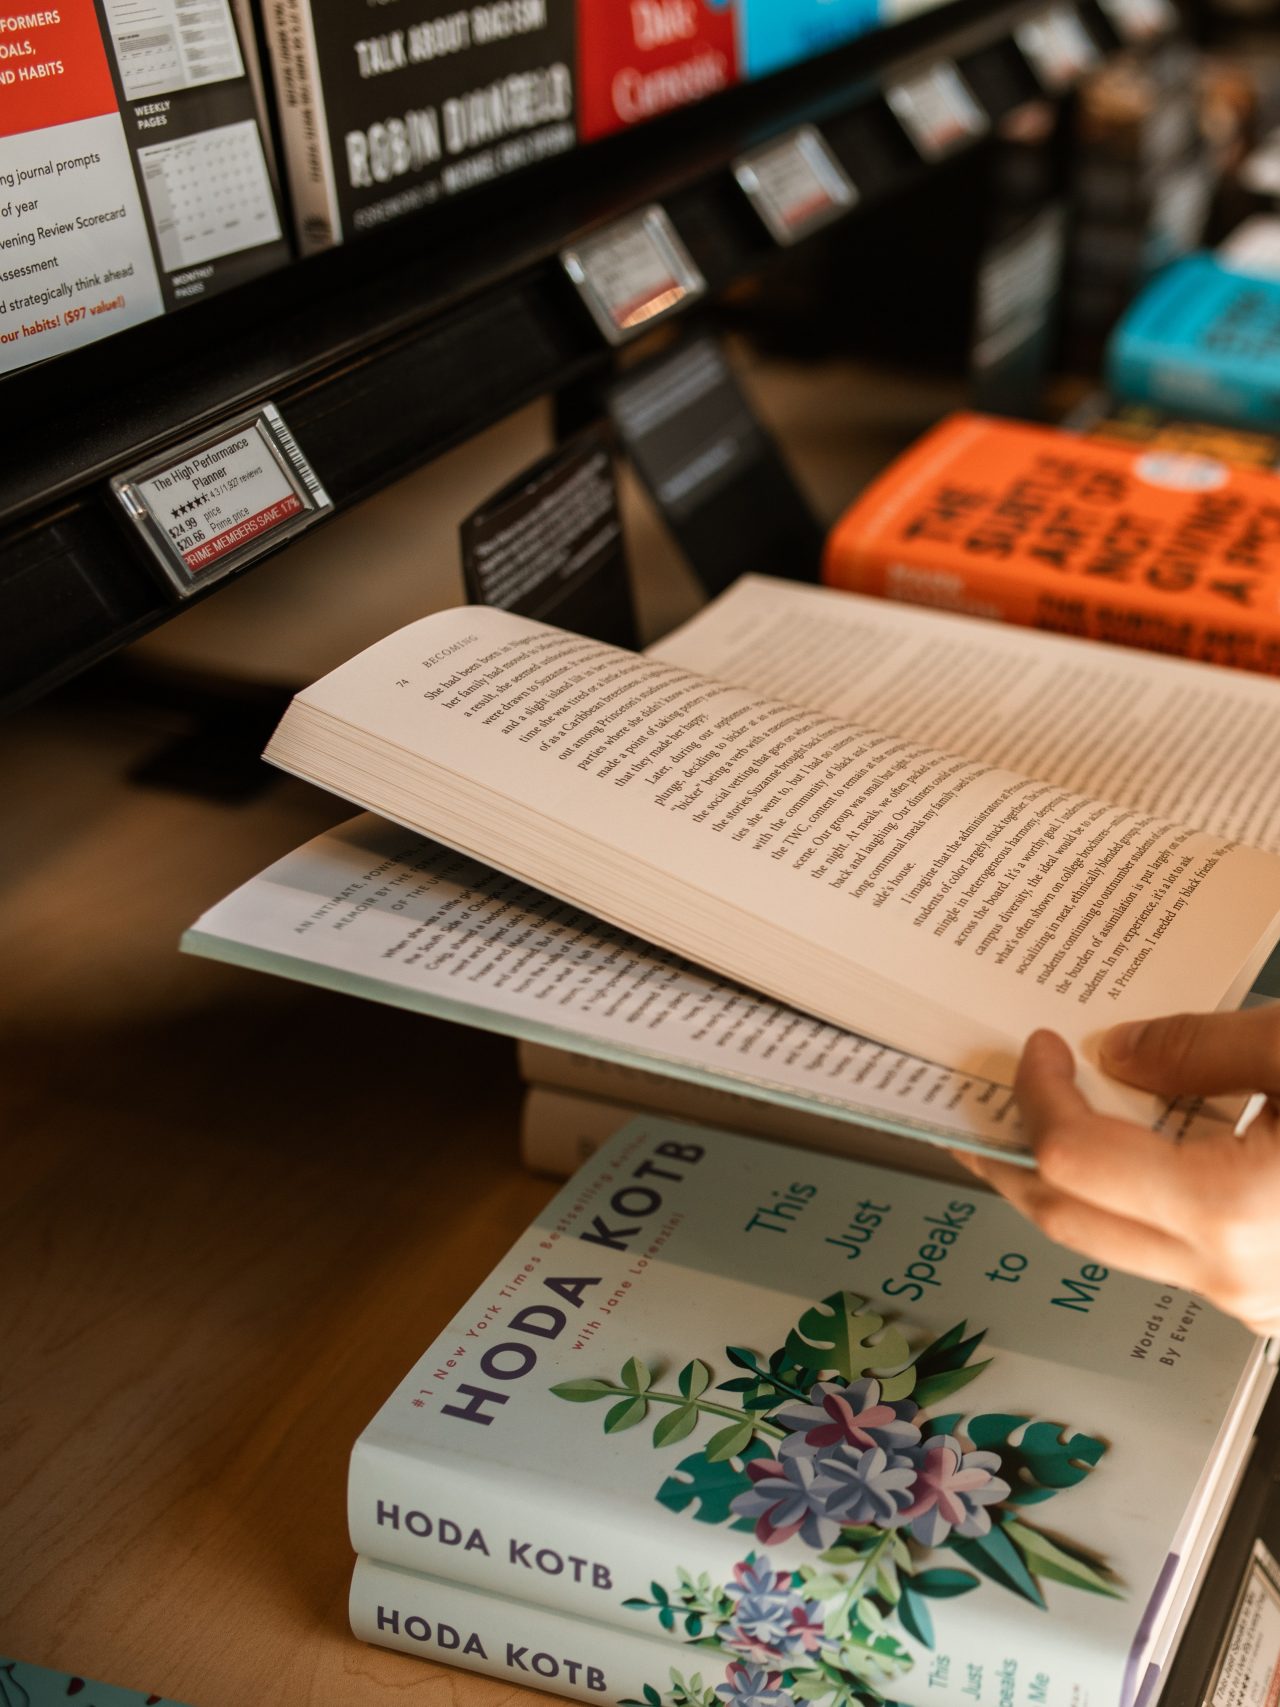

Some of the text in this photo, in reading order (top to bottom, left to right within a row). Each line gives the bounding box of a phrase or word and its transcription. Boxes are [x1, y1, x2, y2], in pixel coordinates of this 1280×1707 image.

[0, 10, 61, 33] FORMERS
[354, 29, 408, 78] TALK
[408, 10, 471, 64] ABOUT
[18, 60, 65, 81] HABITS
[134, 100, 171, 117] WEEKLY
[137, 115, 168, 130] PAGES
[16, 165, 54, 186] journal
[56, 154, 101, 176] prompts
[345, 104, 442, 188] ROBIN
[1, 199, 39, 218] of year
[36, 219, 75, 240] Review
[75, 205, 127, 230] Scorecard
[9, 282, 74, 312] strategically
[75, 273, 102, 292] think
[104, 263, 134, 284] ahead
[1, 330, 20, 344] our
[22, 315, 61, 338] habits!
[63, 306, 87, 327] ($97
[152, 438, 249, 492] The High Performance
[192, 467, 227, 491] Planner
[223, 477, 239, 492] 1,927
[239, 466, 263, 483] reviews
[169, 505, 222, 539] $24.99 price
[177, 506, 250, 552] $20.66 Prime price
[212, 520, 259, 552] MEMBERS
[256, 509, 282, 527] SAVE
[421, 634, 478, 668] BECOMING
[422, 650, 502, 701] She had been born
[396, 679, 409, 688] 74
[557, 724, 605, 760] out among
[613, 713, 707, 787] that they made her happy.
[730, 772, 805, 842] ties she went to, but
[827, 783, 935, 889] back and laughing. Our dinners
[847, 807, 939, 898] long communal meals my
[333, 872, 414, 931] MEMOIR BY THE
[390, 899, 408, 911] OF
[406, 884, 430, 899] THE
[932, 817, 1041, 936] mingle in heterogeneous harmony,
[974, 832, 1077, 956] campus diversity, the ideal would
[294, 882, 368, 934] AN INTIMATE,
[1055, 848, 1174, 994] the burden of assimilation is put largely
[1106, 857, 1219, 1000] At Princeton, I needed my black friends.
[744, 1181, 818, 1235] This
[825, 1198, 892, 1261] Just
[881, 1199, 977, 1302] Speaks
[984, 1250, 1029, 1284] to
[411, 1388, 434, 1409] #1
[433, 1345, 468, 1381] New
[465, 1304, 502, 1340] York
[498, 1256, 542, 1299] Times
[539, 1173, 614, 1251] Bestselling
[440, 1276, 604, 1426] HODA
[580, 1140, 706, 1252] KOTB
[573, 1211, 686, 1352] with Jane Lorenzini
[1050, 1261, 1111, 1314] Me
[1130, 1294, 1173, 1359] Words to
[1158, 1300, 1203, 1367] By Every
[376, 1499, 614, 1591] HODA KOTB
[376, 1604, 608, 1693] HODA KOTB
[928, 1655, 951, 1689] This
[961, 1663, 984, 1701] Just
[1026, 1671, 1051, 1705] Me
